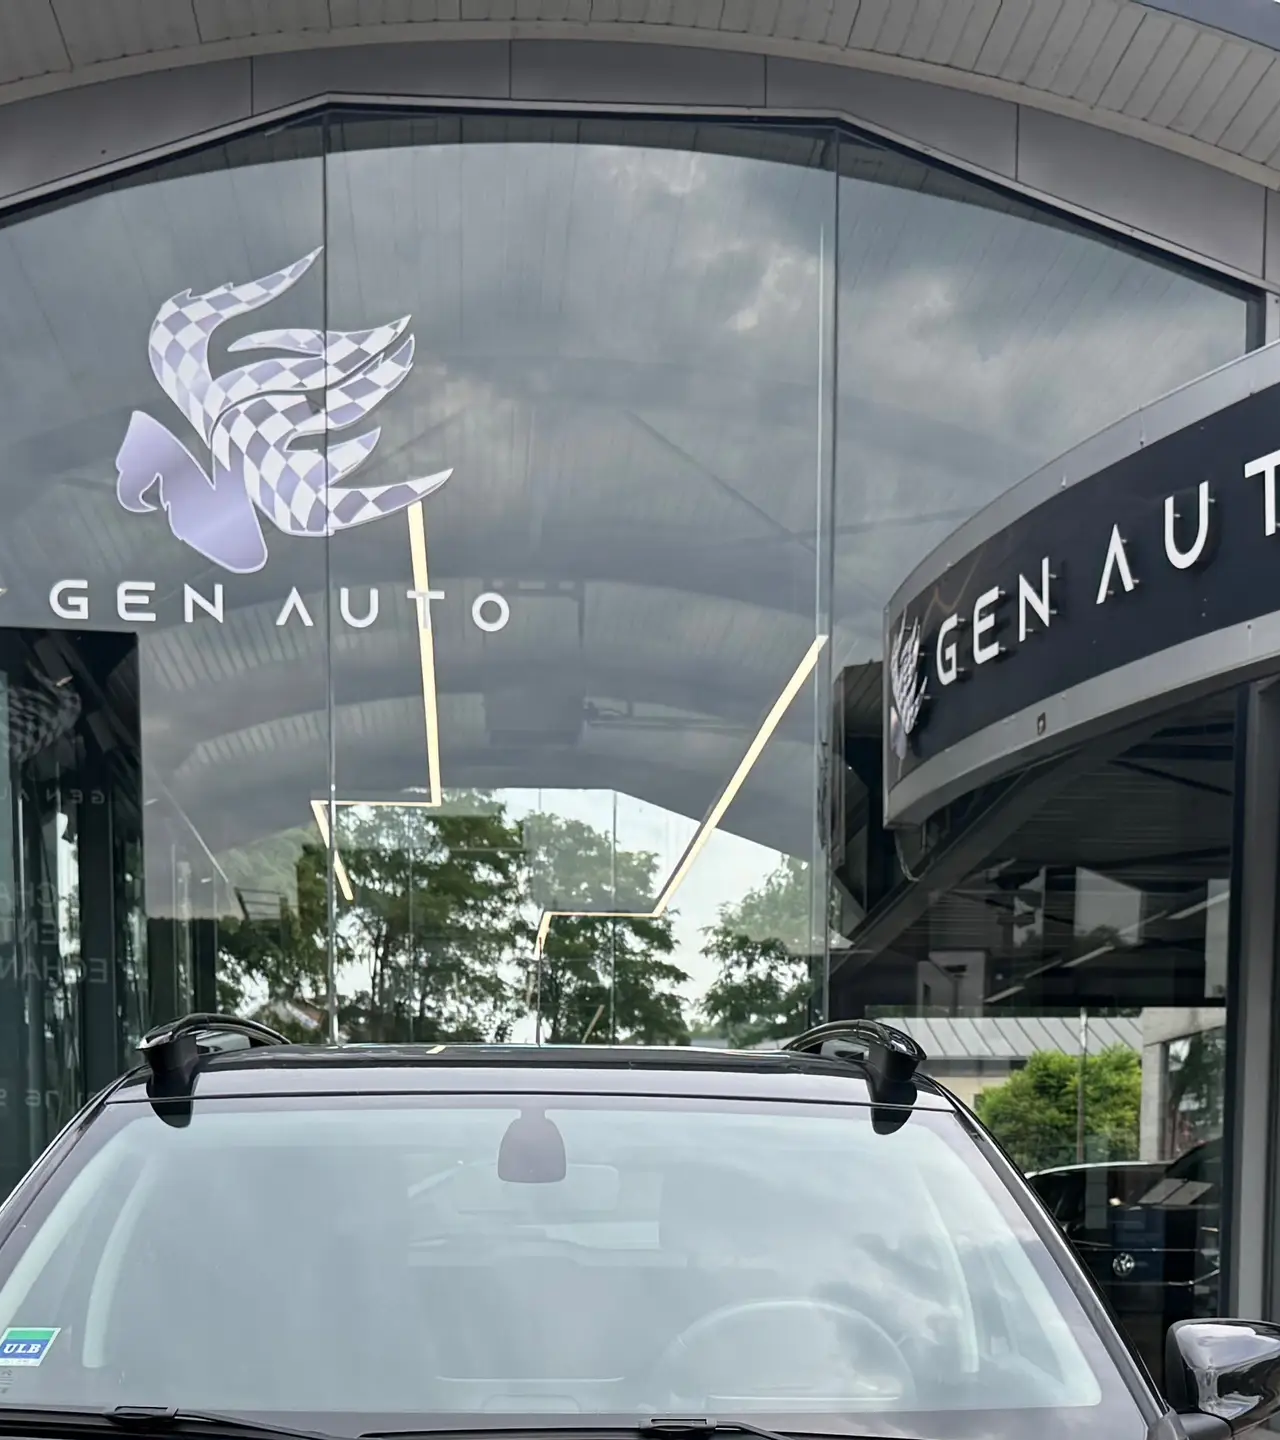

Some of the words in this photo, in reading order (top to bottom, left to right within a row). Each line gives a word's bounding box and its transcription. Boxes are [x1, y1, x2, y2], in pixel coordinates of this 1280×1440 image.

[49, 579, 225, 623] GEN
[276, 587, 511, 632] AUTO
[936, 555, 1050, 686] GEN
[3, 1343, 42, 1354] ULB
